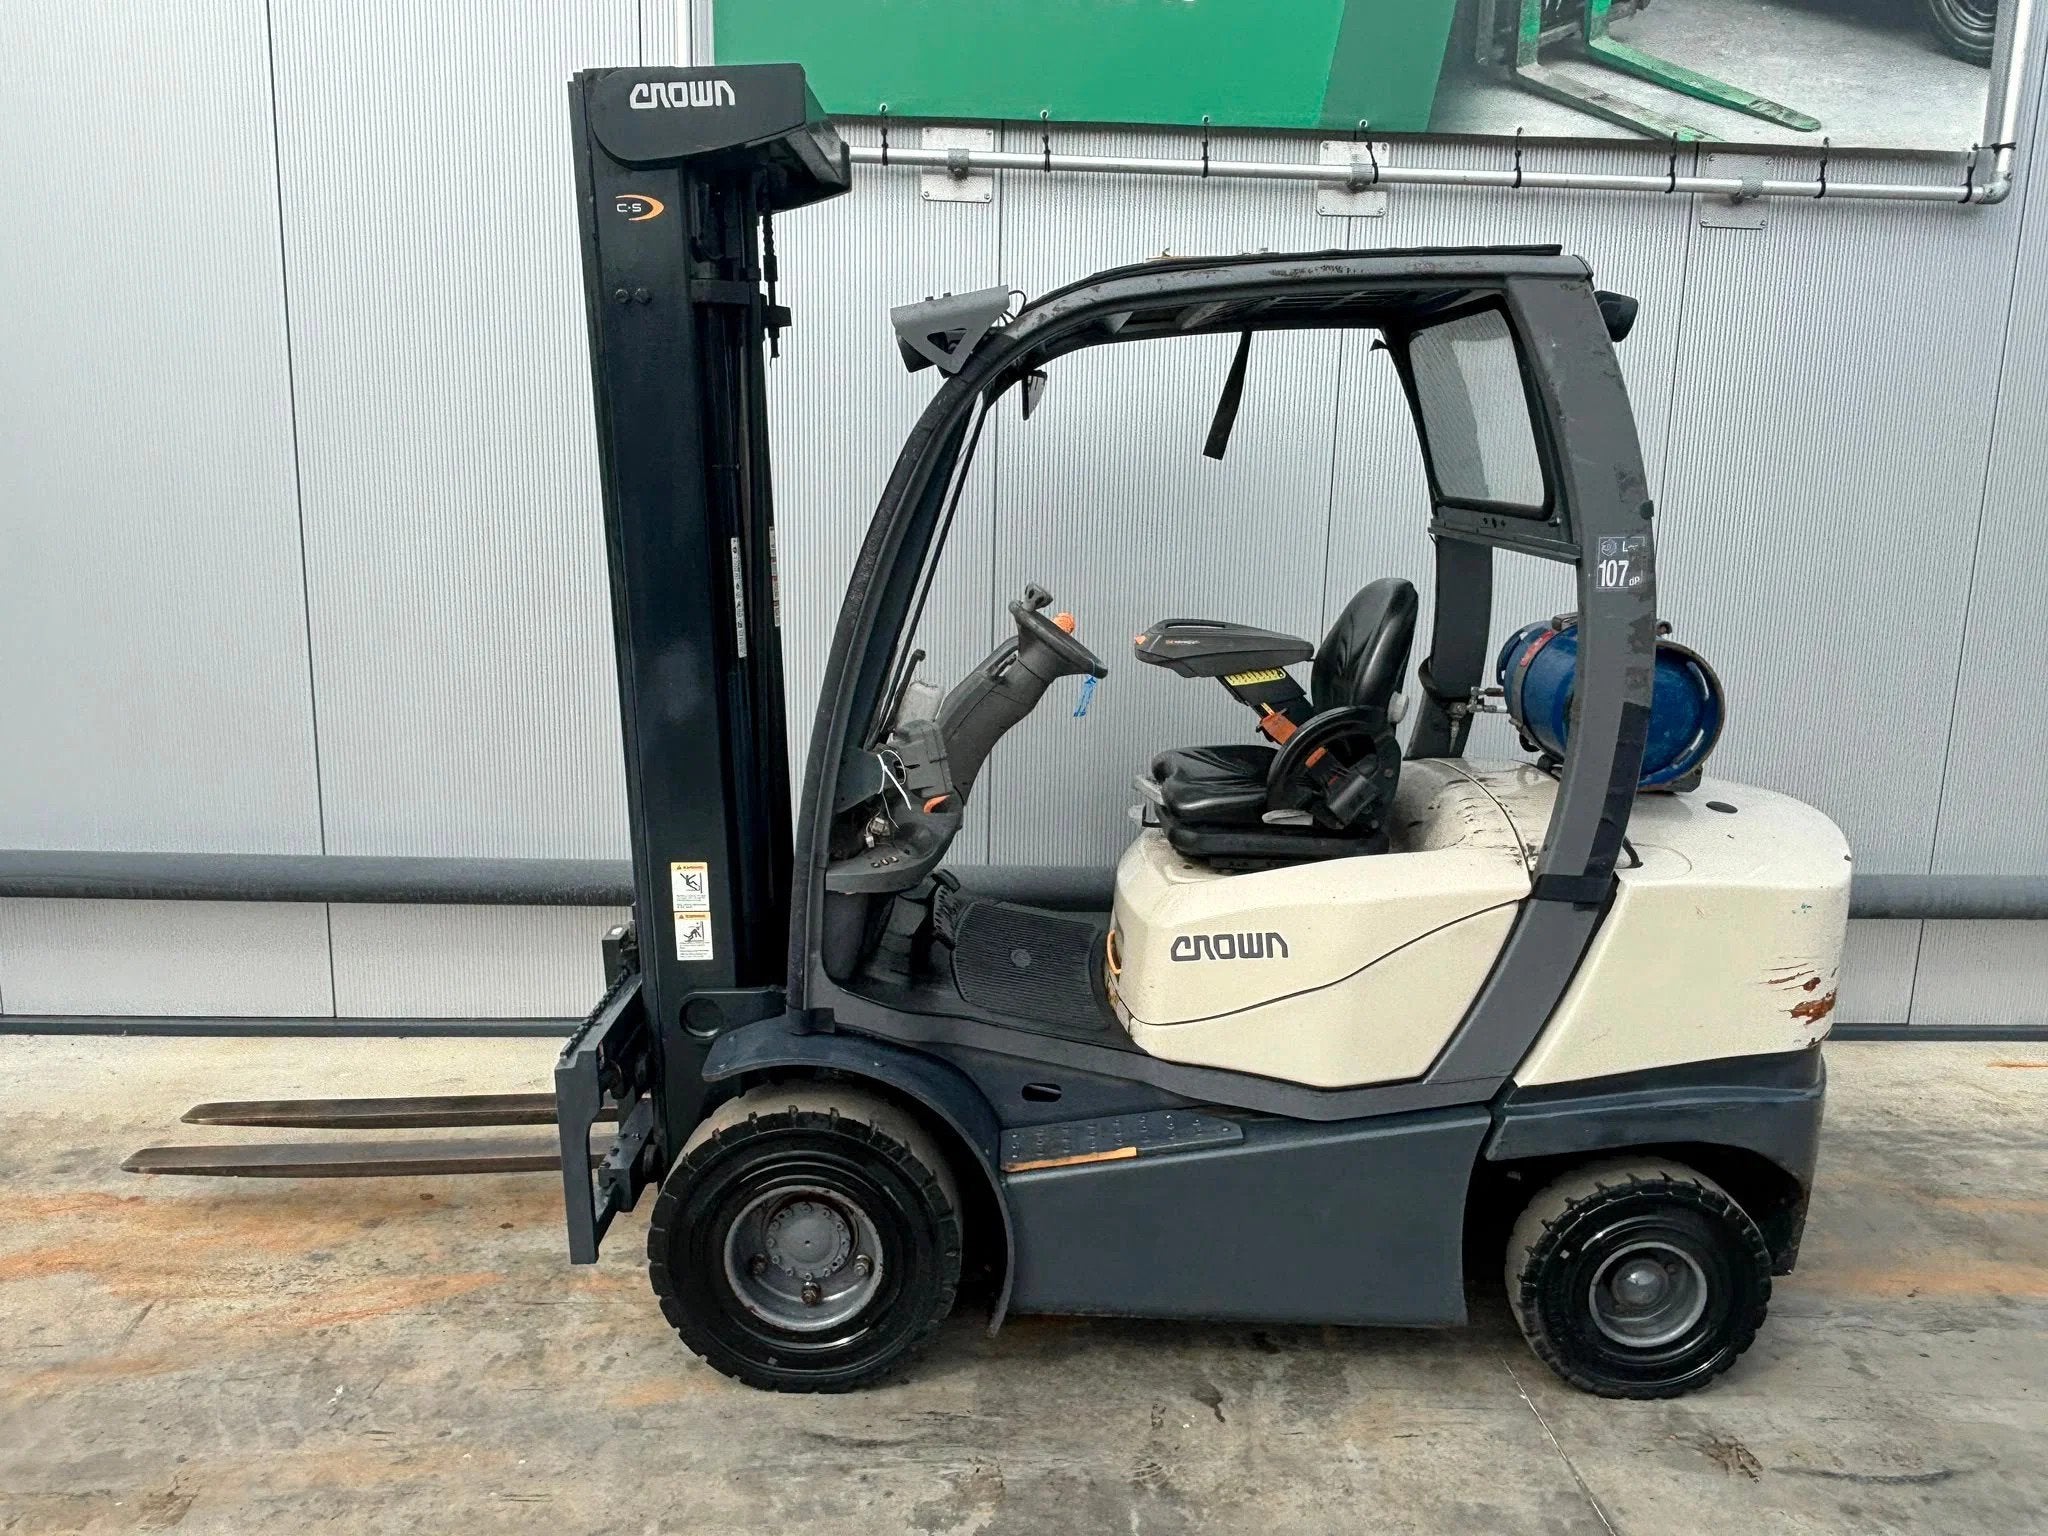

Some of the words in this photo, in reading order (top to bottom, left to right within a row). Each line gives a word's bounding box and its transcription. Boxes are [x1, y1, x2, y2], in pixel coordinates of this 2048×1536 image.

[630, 80, 736, 109] CROWN
[1599, 559, 1629, 587] 107
[1170, 932, 1289, 962] CROWN
